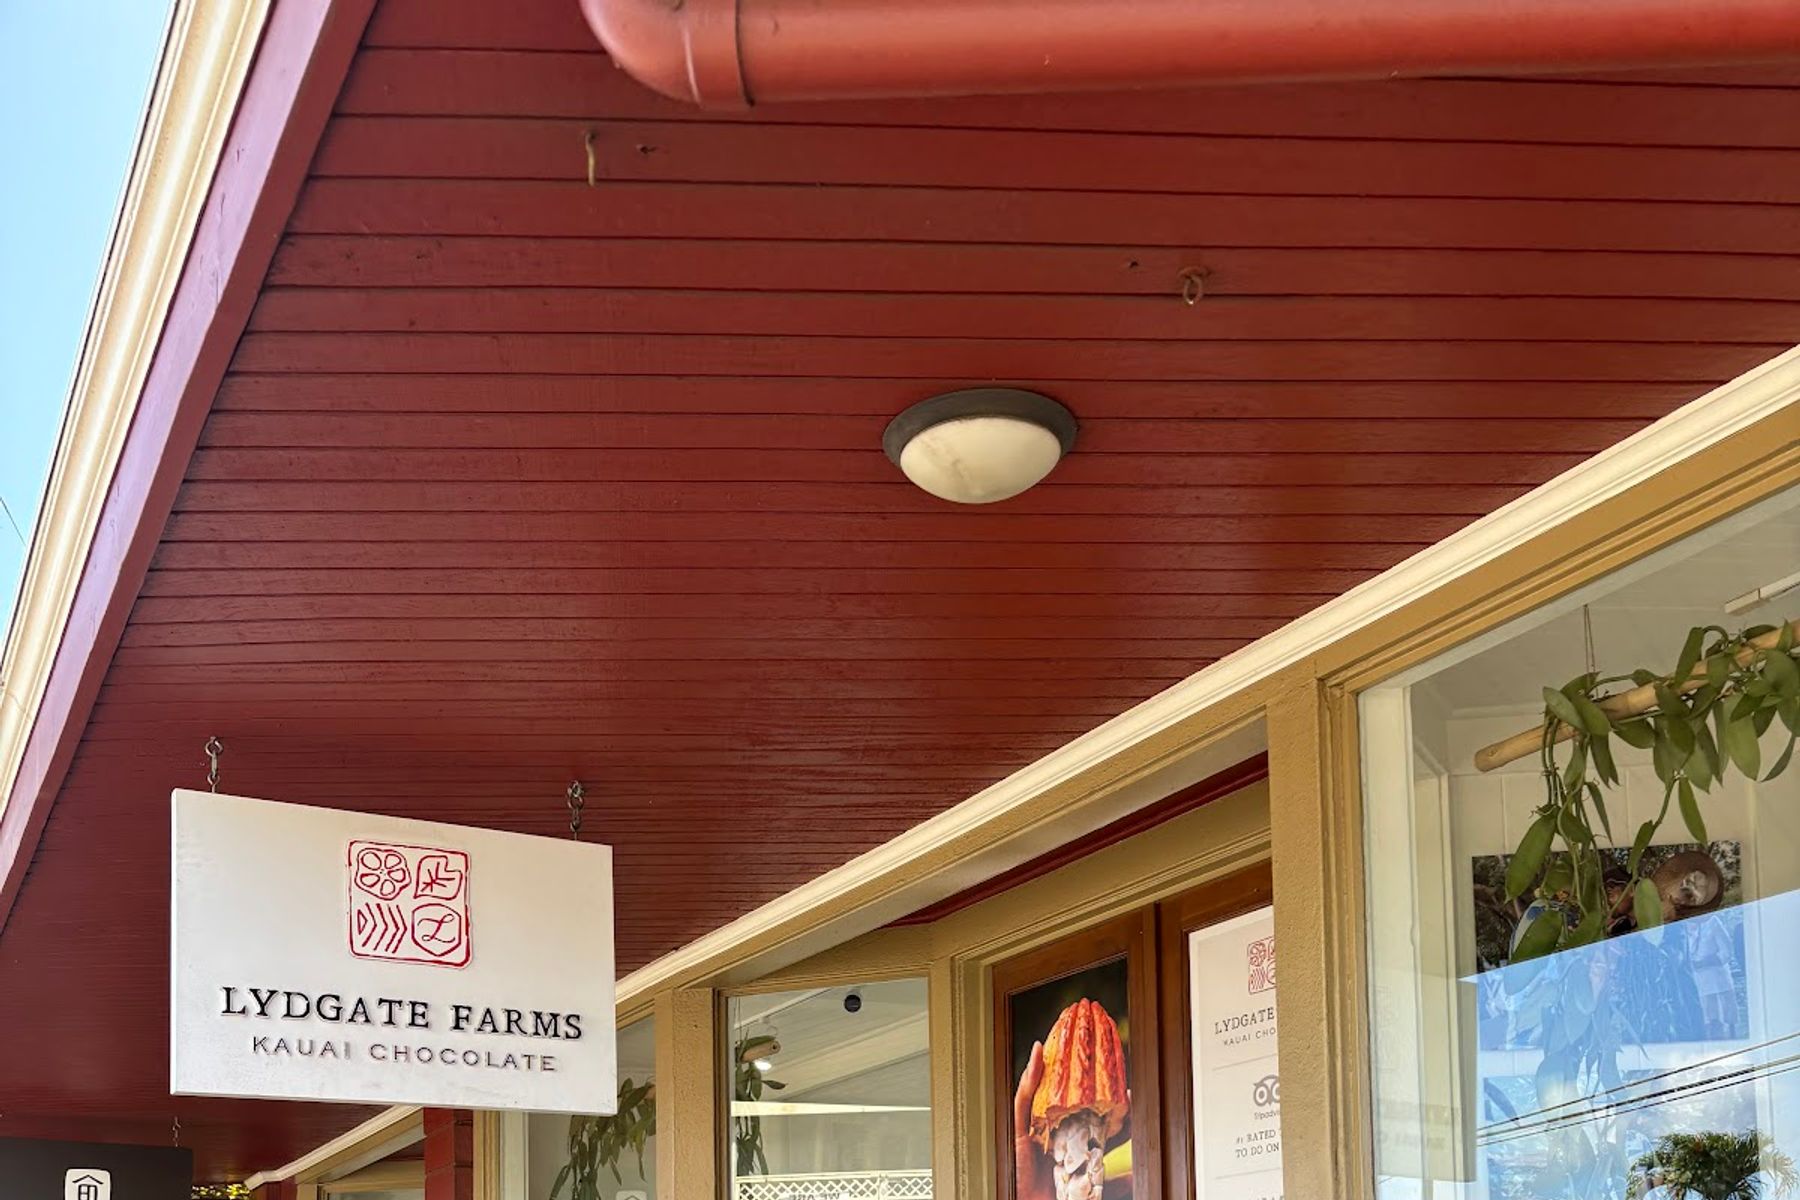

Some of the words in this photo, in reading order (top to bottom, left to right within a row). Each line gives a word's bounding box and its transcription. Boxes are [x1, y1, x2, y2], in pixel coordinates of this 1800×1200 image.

[220, 985, 430, 1029] LYDGATE
[450, 1004, 583, 1040] FARMS
[1214, 1006, 1275, 1035] LYDGATE
[252, 1035, 352, 1060] KAUAI
[369, 1042, 558, 1073] CHOCOLATE
[1235, 1147, 1248, 1158] TO
[1250, 1144, 1263, 1156] DO
[1266, 1142, 1280, 1153] ON
[1246, 1129, 1276, 1143] RATED
